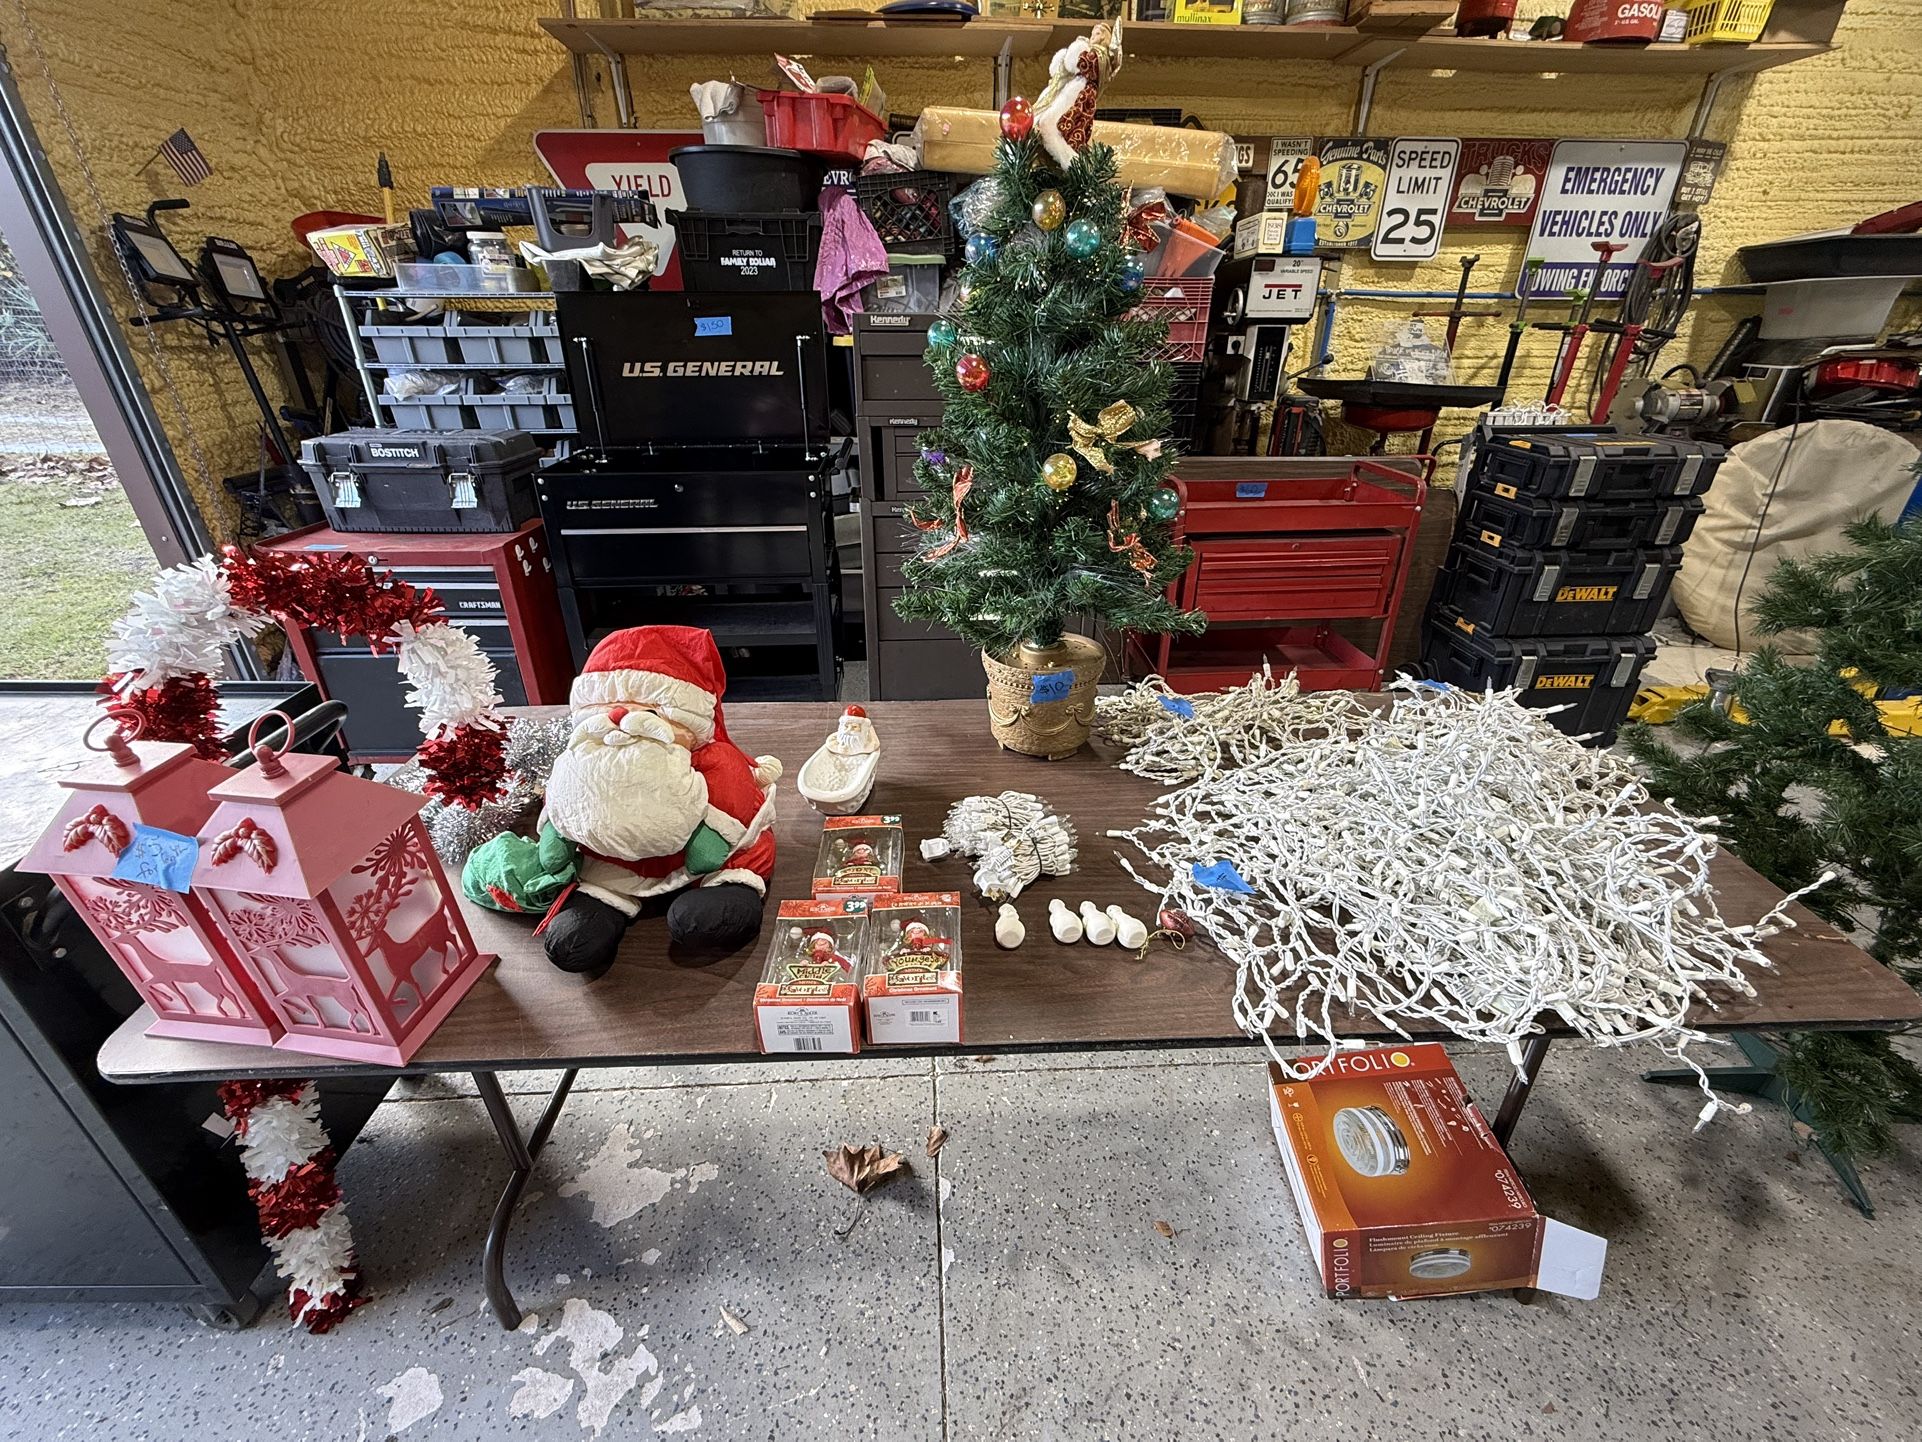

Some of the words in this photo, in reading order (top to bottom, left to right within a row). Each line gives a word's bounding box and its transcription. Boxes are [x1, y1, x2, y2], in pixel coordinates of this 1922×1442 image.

[1321, 141, 1361, 165] Genuine
[1362, 141, 1387, 165] Parts
[1462, 141, 1550, 175] TRUCKS
[1395, 151, 1451, 169] SPEED
[611, 175, 671, 197] YIELD
[1396, 176, 1443, 195] LIMIT
[1560, 166, 1666, 196] EMERGENCY
[1320, 204, 1370, 213] CHEVROLET
[1461, 197, 1528, 209] CHEVROLET
[1380, 207, 1439, 246] 25
[1538, 210, 1618, 238] VEHICLES
[1618, 210, 1664, 239] ONLY
[720, 257, 748, 266] FAMILY
[749, 257, 776, 268] DOLLAR
[740, 266, 758, 275] 2023
[1262, 289, 1302, 300] JET
[701, 320, 724, 331] $150
[870, 315, 911, 326] Kennedy
[622, 362, 663, 377] U.S.
[666, 361, 785, 377] GENERAL
[889, 418, 918, 426] Kennedy
[371, 448, 420, 458] BOSTITCH
[591, 499, 659, 509] GENERAL
[458, 601, 502, 609] CRAFTSMAN
[1333, 1238, 1350, 1297] PORTFOLIO
